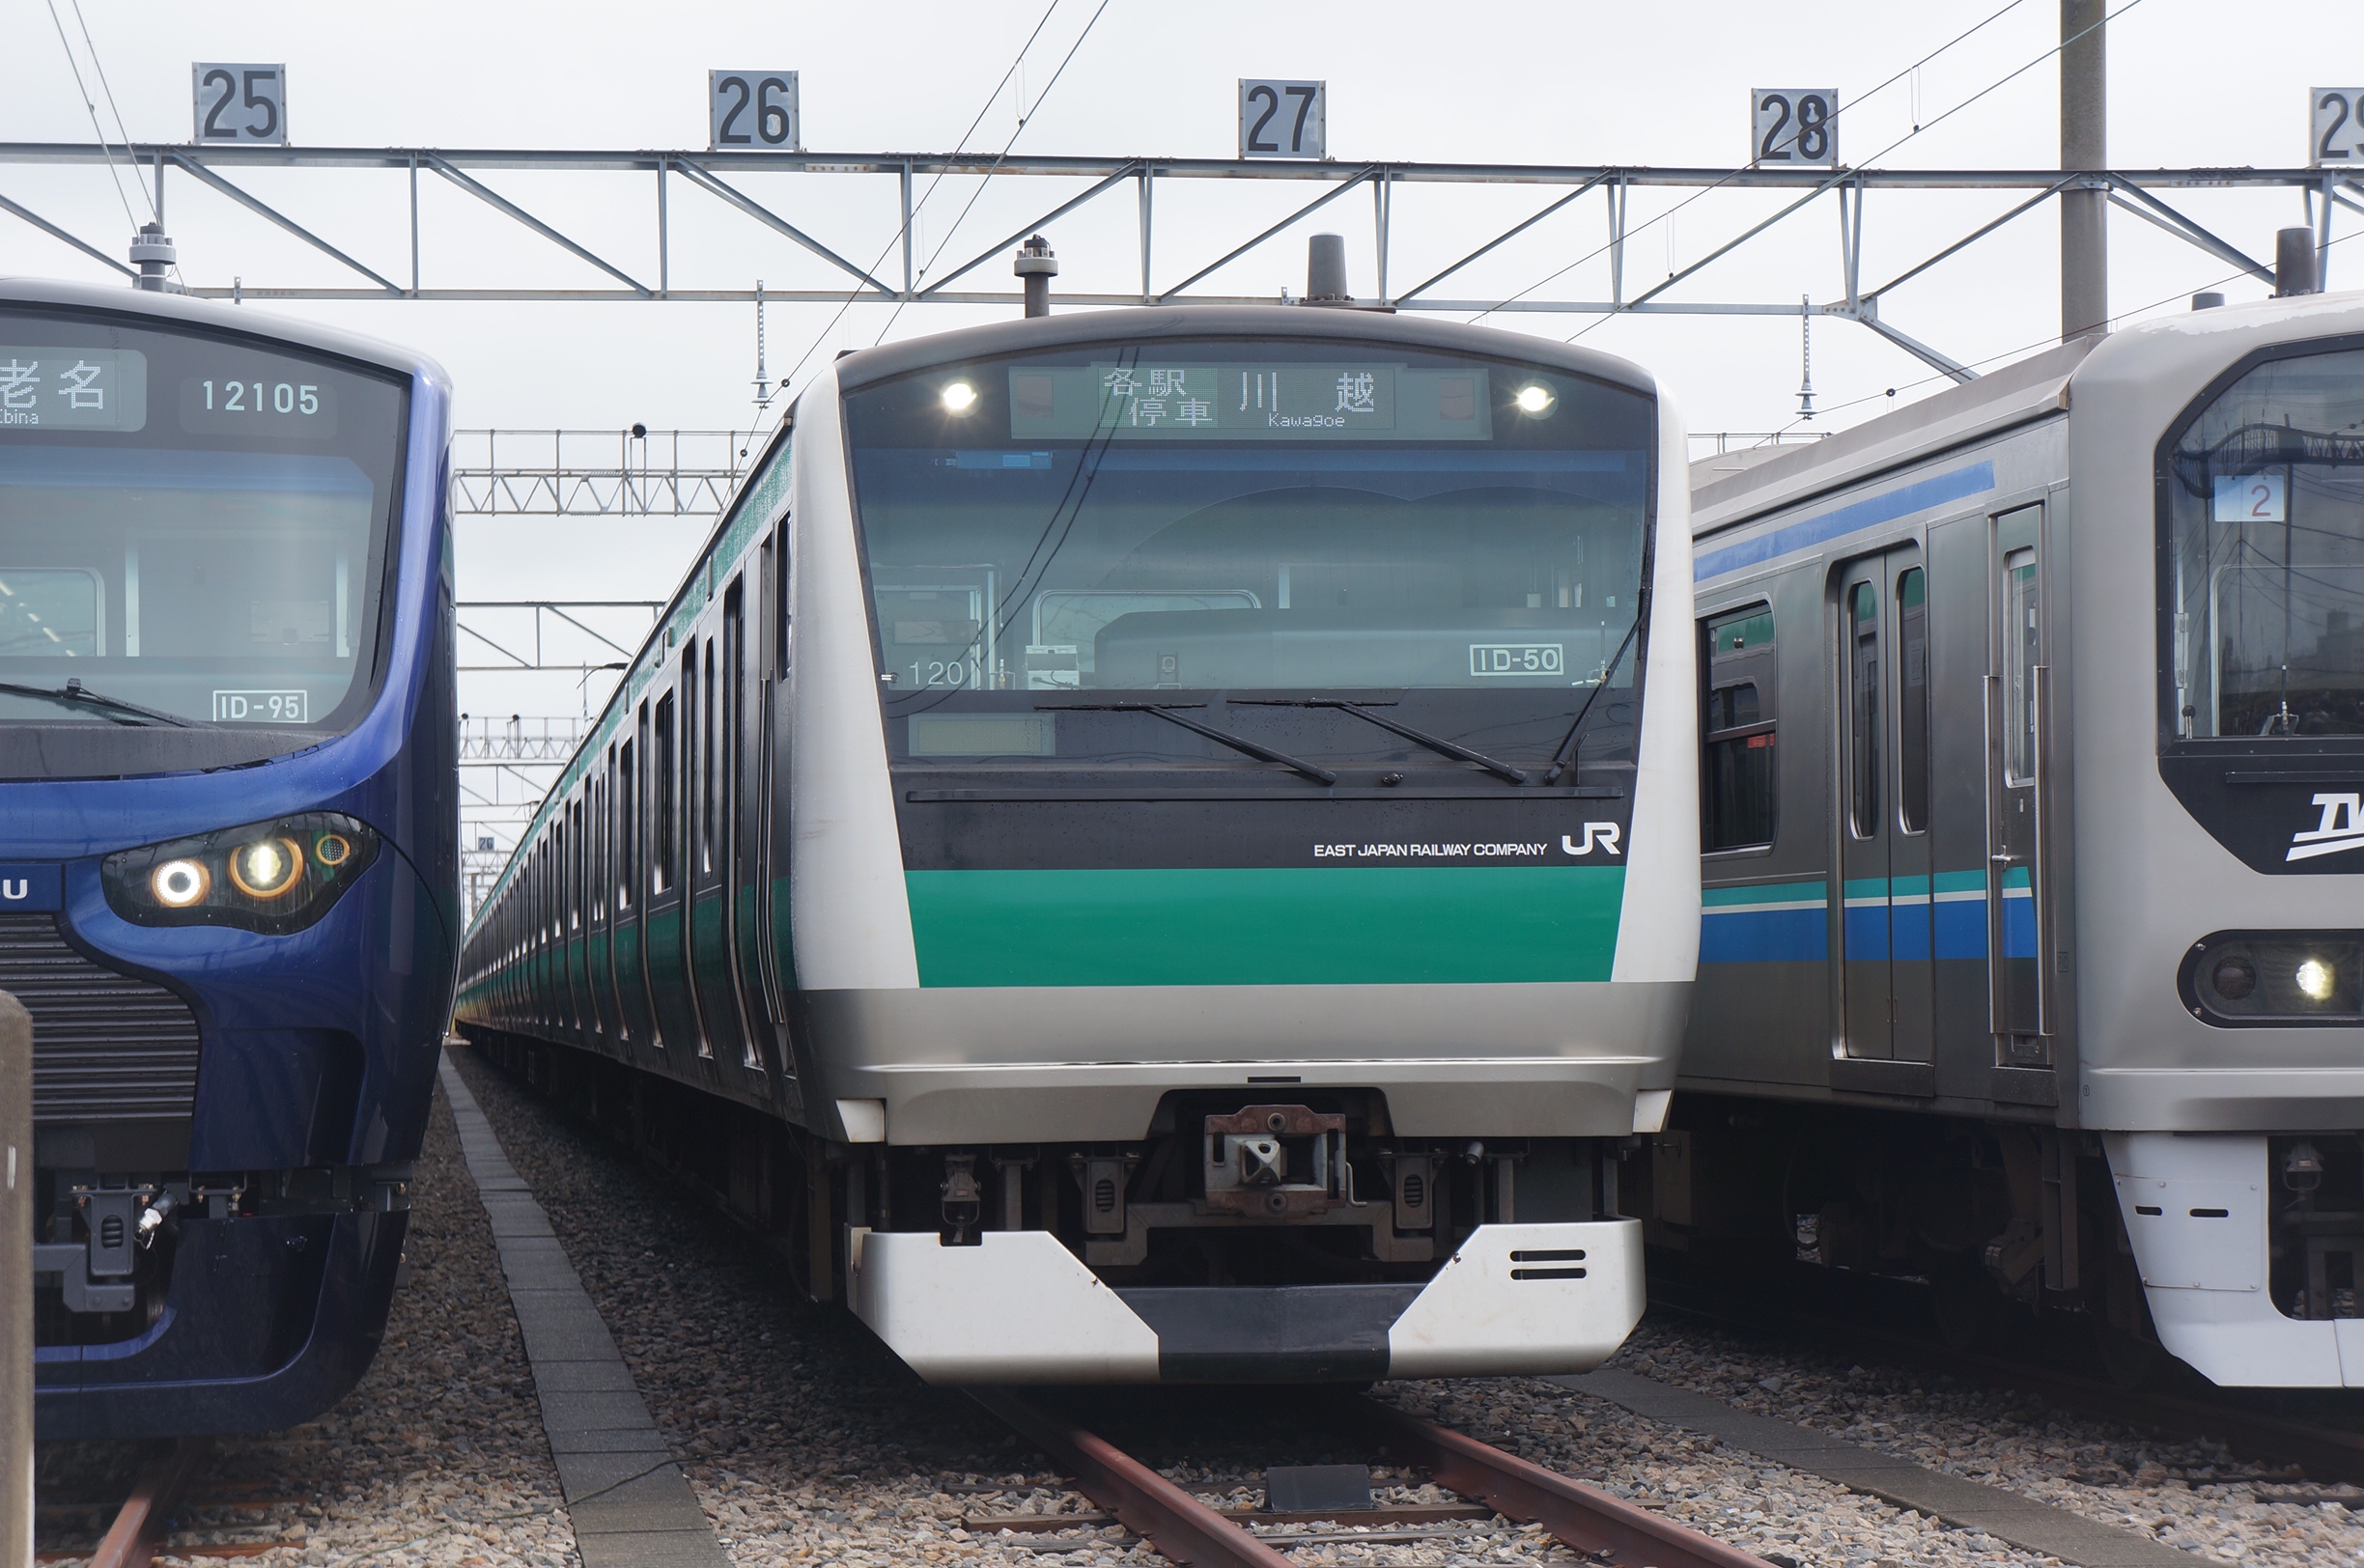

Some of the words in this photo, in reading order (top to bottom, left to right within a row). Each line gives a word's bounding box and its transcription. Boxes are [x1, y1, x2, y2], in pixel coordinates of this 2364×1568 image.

[203, 69, 278, 139] 25
[718, 76, 791, 144] 26
[1247, 84, 1317, 153] 27
[1759, 93, 1829, 161] 28
[203, 379, 319, 415] 12105
[1104, 367, 1188, 397] 各駅
[1128, 397, 1213, 427] 停車
[1268, 412, 1345, 427] Kawagoe
[2250, 484, 2271, 518] 2
[909, 661, 963, 686] 120
[1480, 648, 1559, 671] ID-50
[221, 695, 299, 719] ID-95
[1313, 844, 1356, 857] EAST
[1357, 844, 1408, 857] JAPAN
[1409, 843, 1472, 856] RAILWAY
[1473, 843, 1548, 856] COMPANY
[1562, 822, 1620, 855] JR
